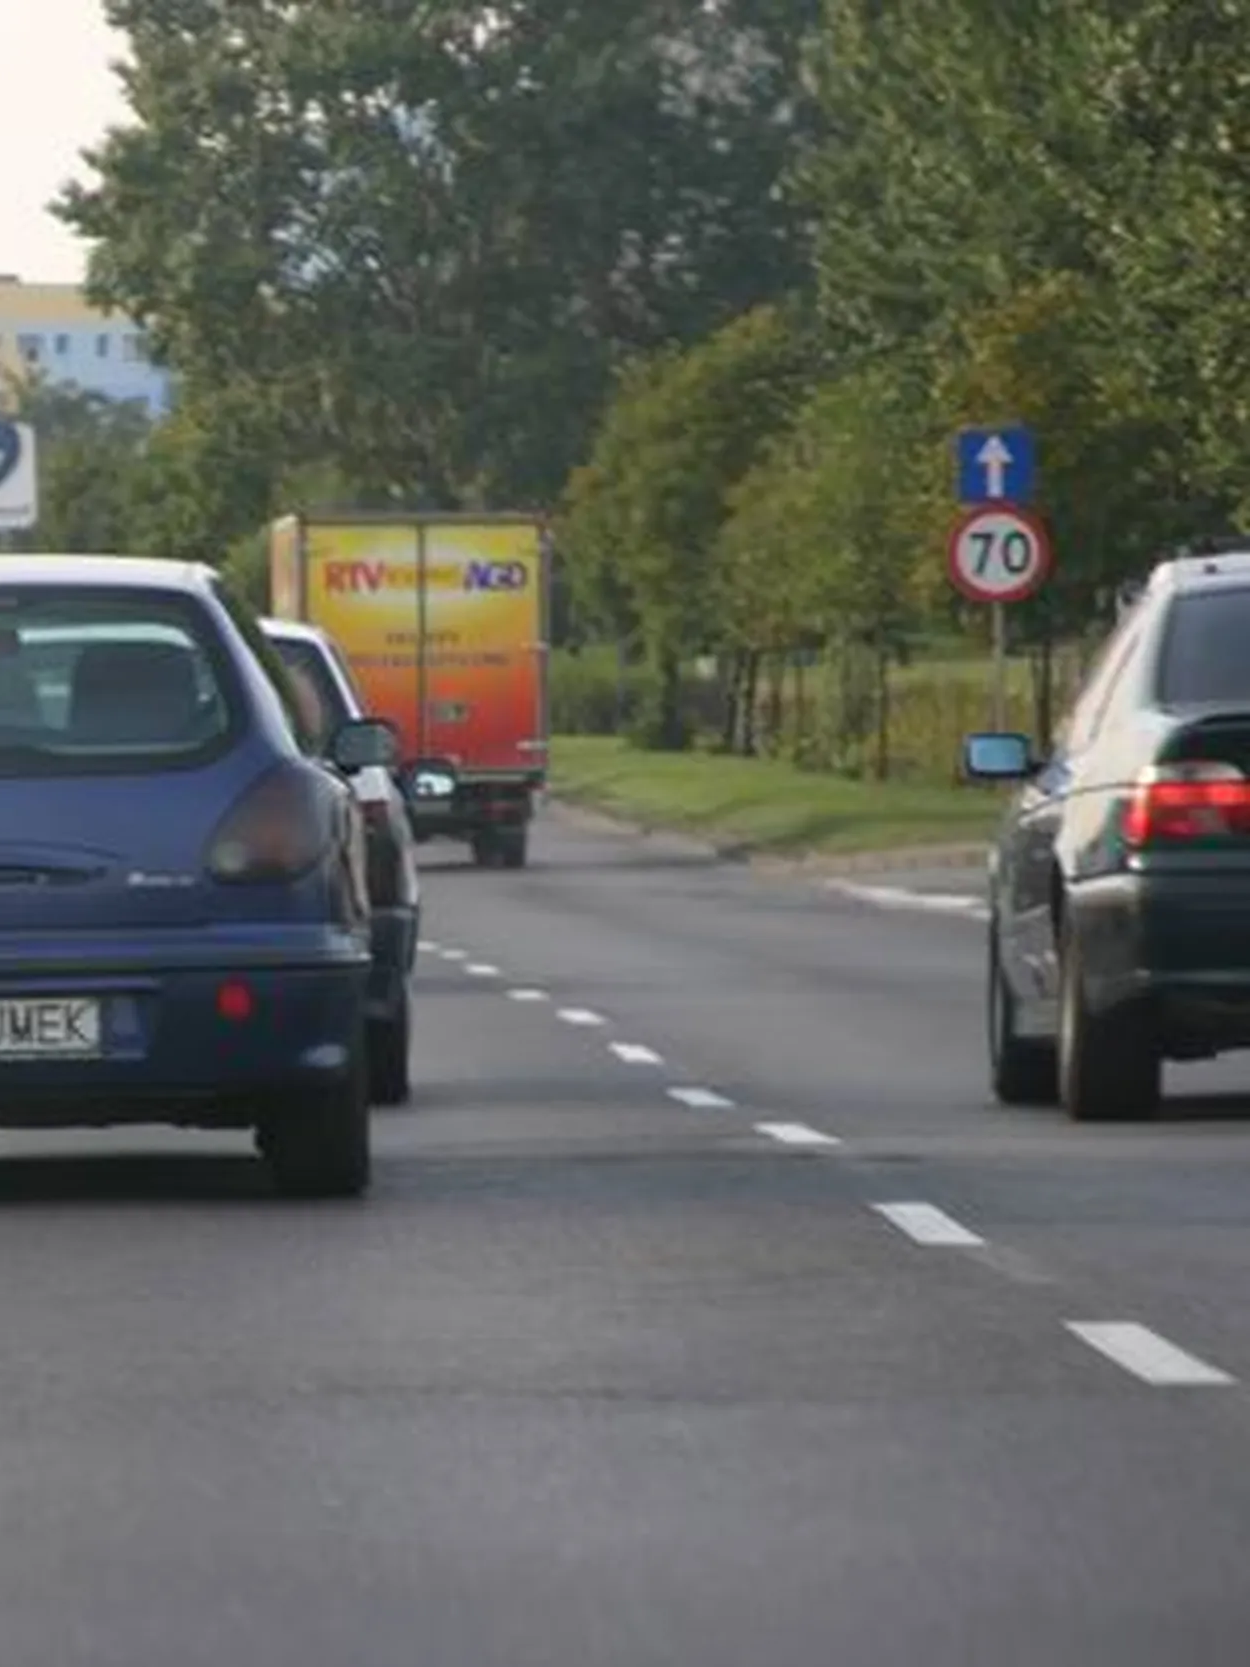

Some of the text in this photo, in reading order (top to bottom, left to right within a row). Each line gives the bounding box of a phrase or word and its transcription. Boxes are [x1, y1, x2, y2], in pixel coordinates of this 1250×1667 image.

[969, 531, 1032, 576] 70
[323, 561, 385, 593] RTV
[463, 560, 528, 590] AGD
